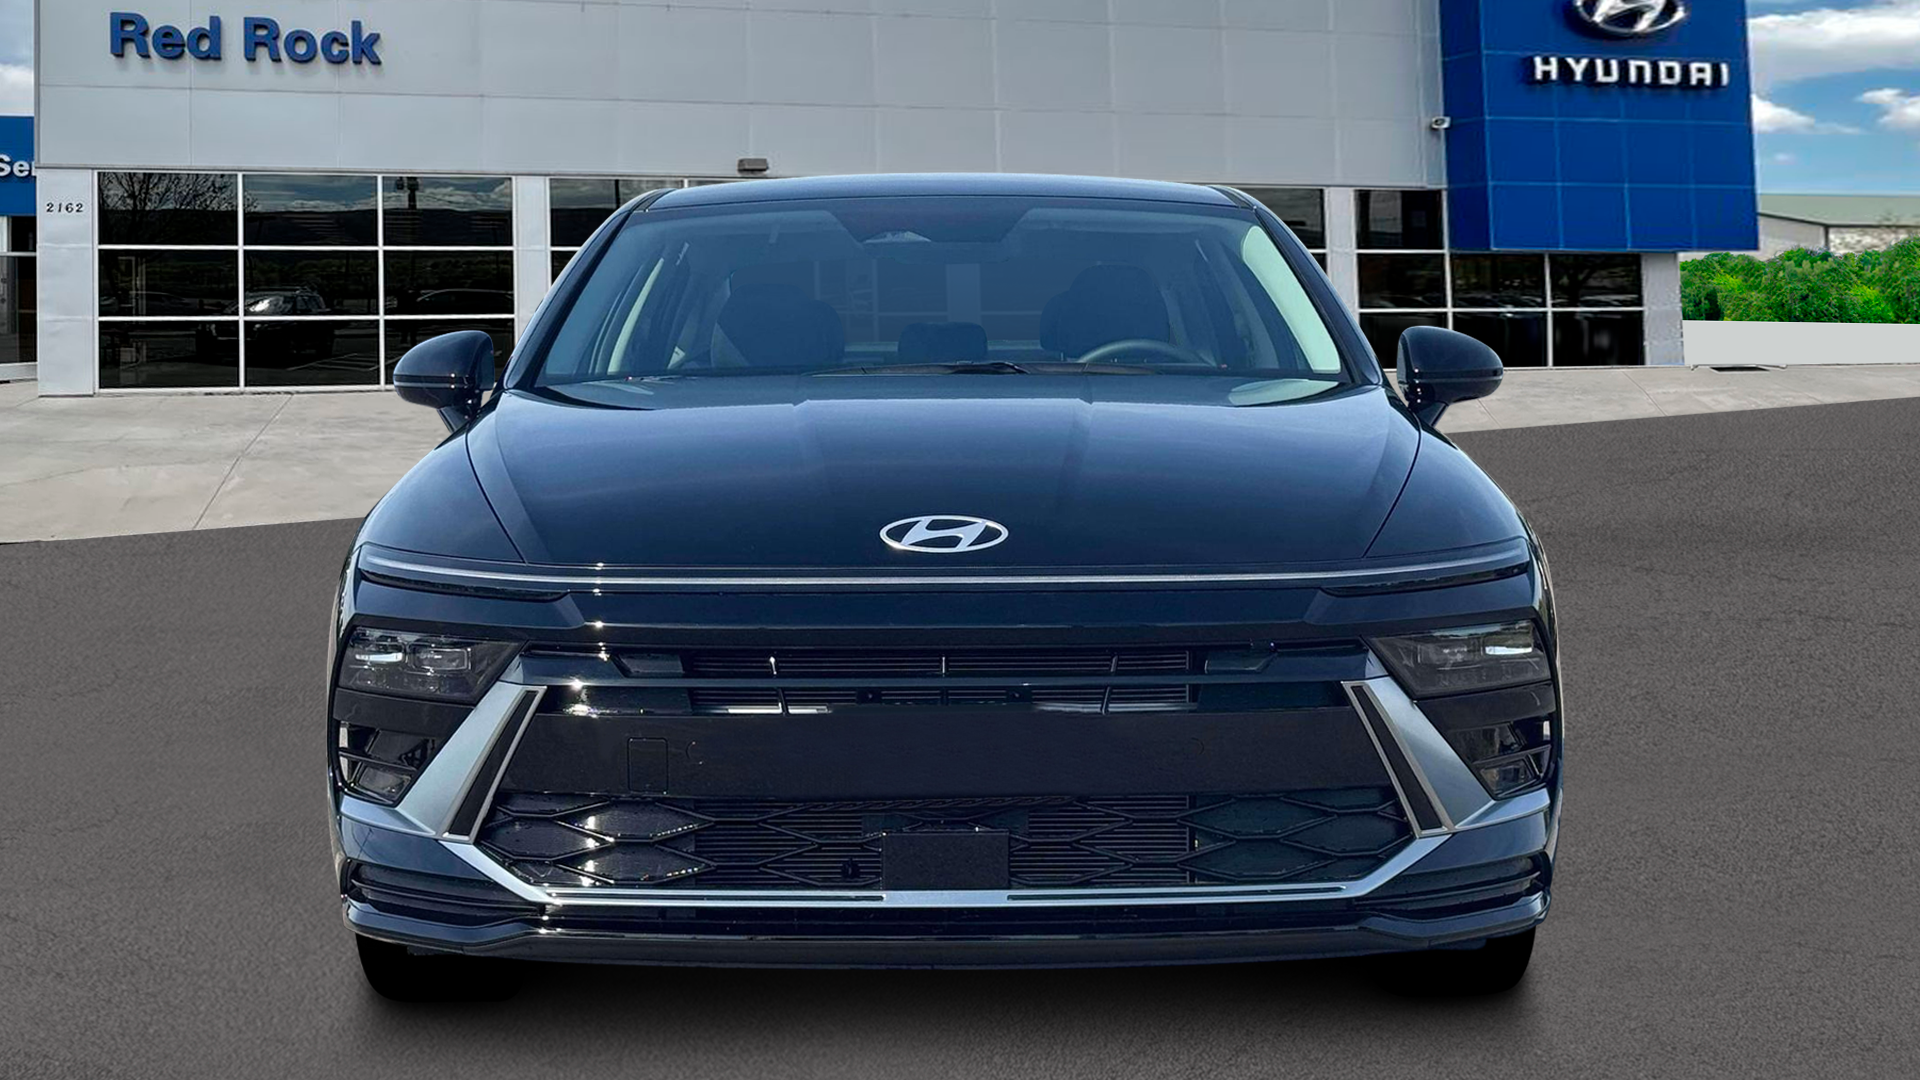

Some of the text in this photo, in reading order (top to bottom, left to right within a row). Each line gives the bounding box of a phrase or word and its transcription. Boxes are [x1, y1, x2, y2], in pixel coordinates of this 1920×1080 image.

[110, 12, 382, 64] Red Rock
[1533, 55, 1730, 87] HYUNDAI
[46, 202, 84, 213] 2162
